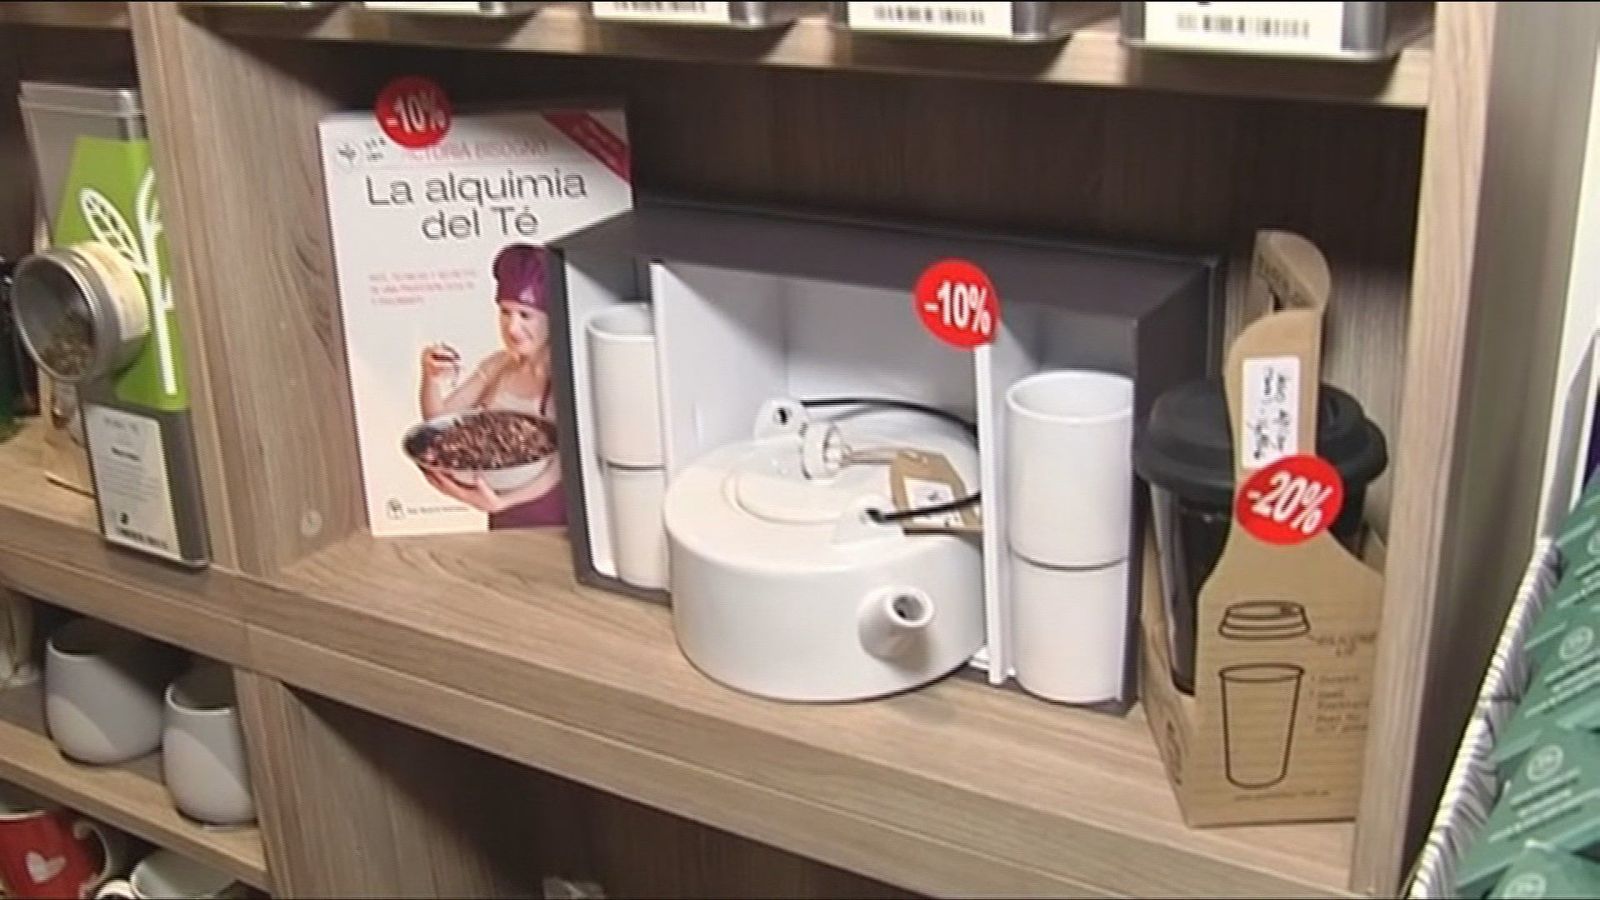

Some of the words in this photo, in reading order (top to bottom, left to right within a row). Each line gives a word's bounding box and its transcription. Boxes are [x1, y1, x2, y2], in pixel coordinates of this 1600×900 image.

[386, 90, 446, 134] -10%
[365, 174, 413, 206] La
[425, 168, 588, 207] alquimia
[421, 208, 481, 240] del
[491, 205, 539, 237] Té
[923, 279, 992, 336] -10%
[1246, 470, 1334, 534] -20%
